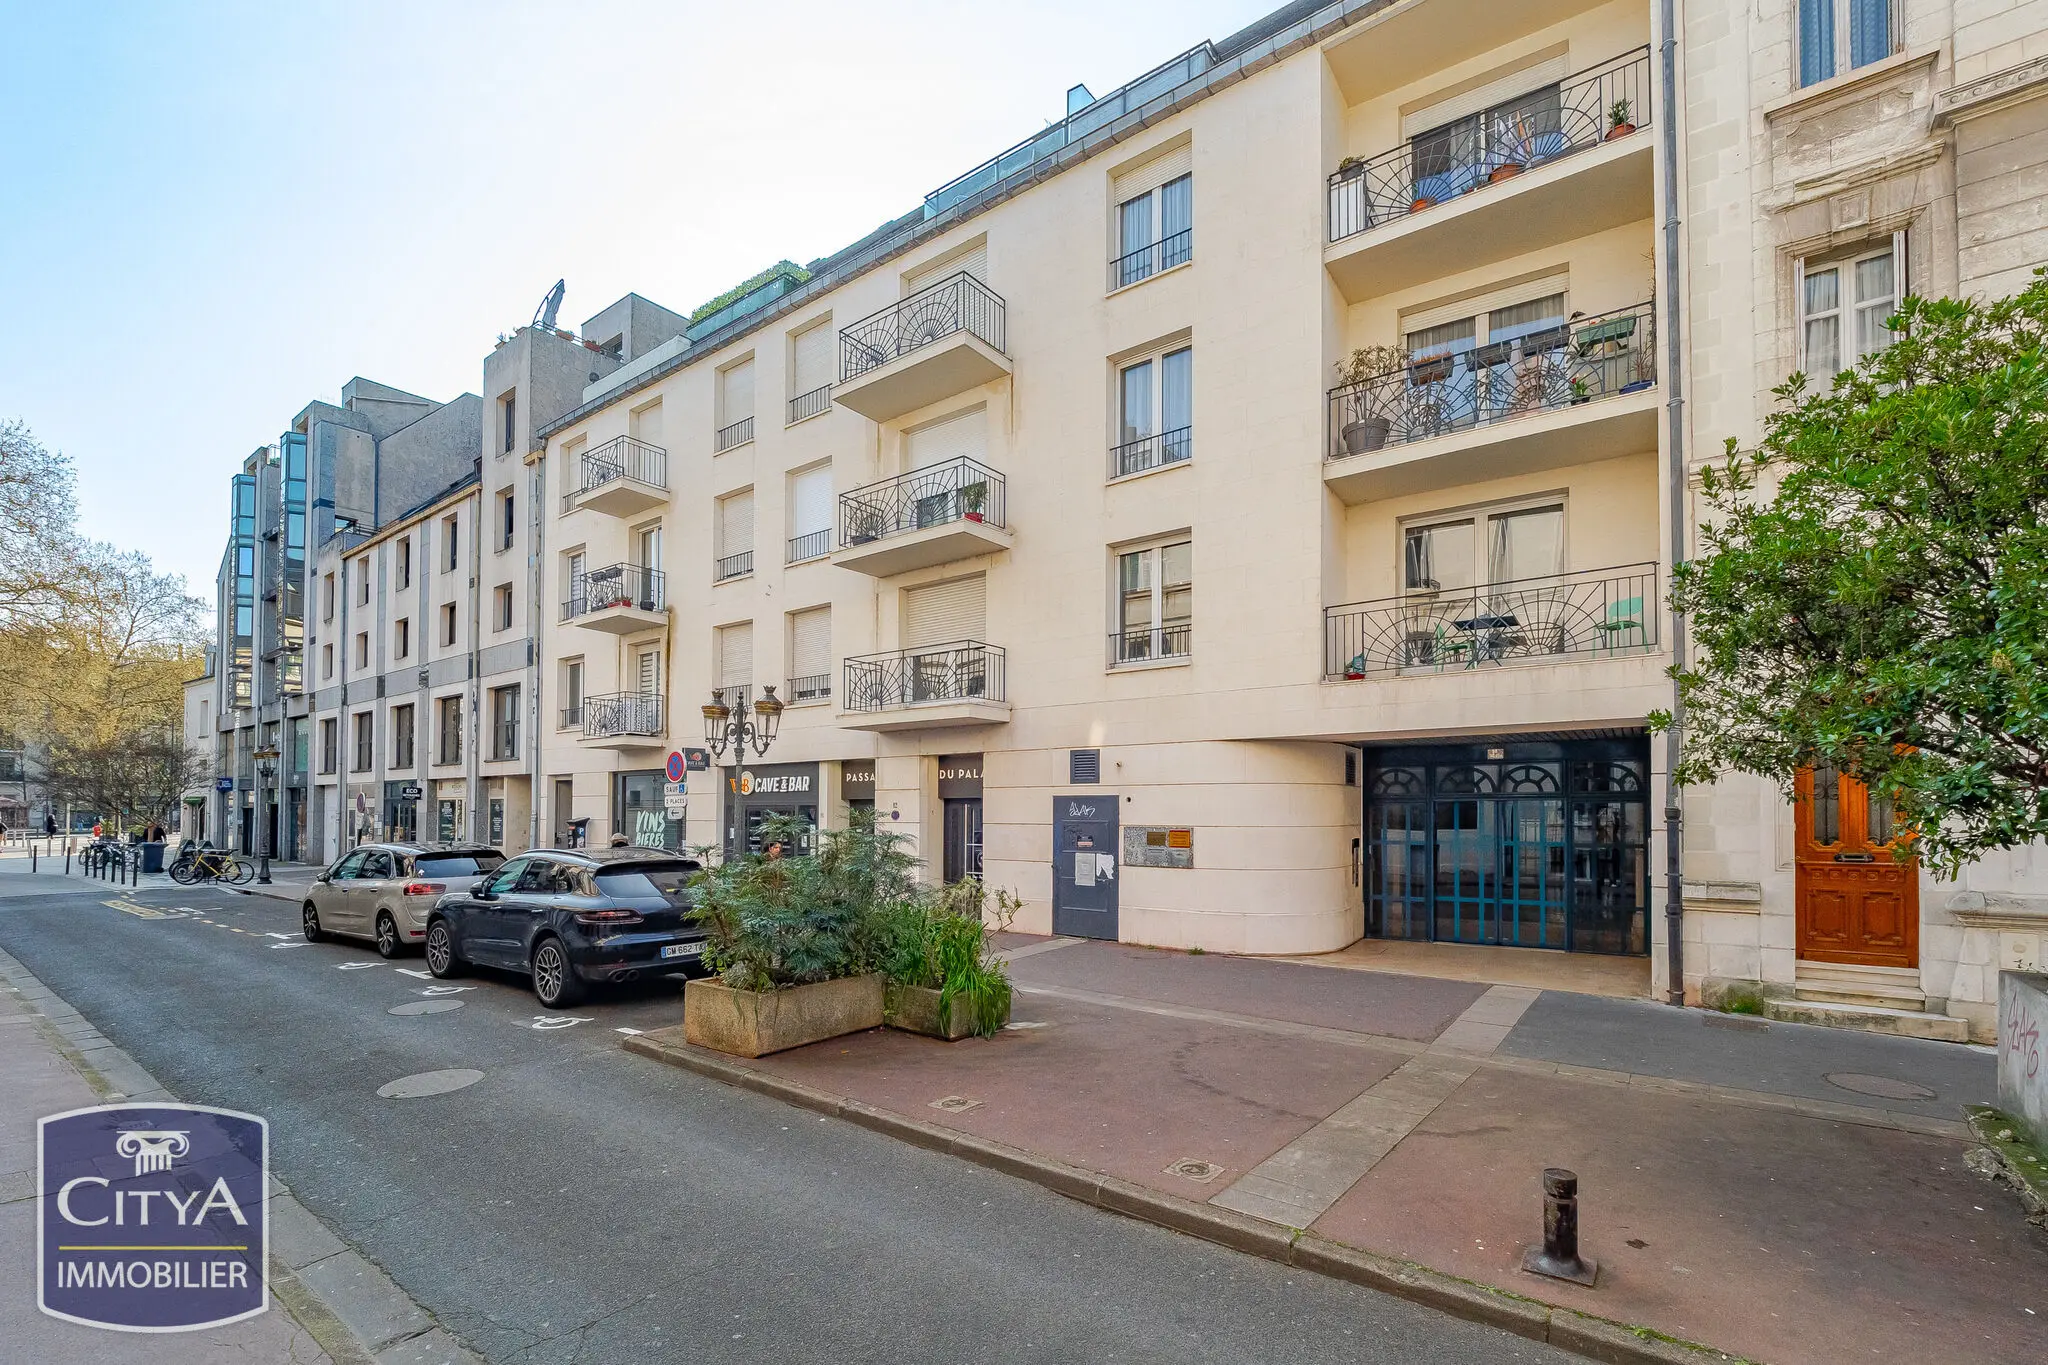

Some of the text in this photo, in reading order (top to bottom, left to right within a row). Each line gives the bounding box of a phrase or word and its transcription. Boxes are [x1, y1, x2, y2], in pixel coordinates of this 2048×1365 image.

[846, 772, 875, 782] PASSA
[939, 769, 954, 779] DU
[755, 777, 780, 793] CAVE
[780, 776, 788, 792] &
[788, 776, 810, 792] BAR
[636, 810, 665, 832] VINS
[636, 832, 665, 849] BIERES
